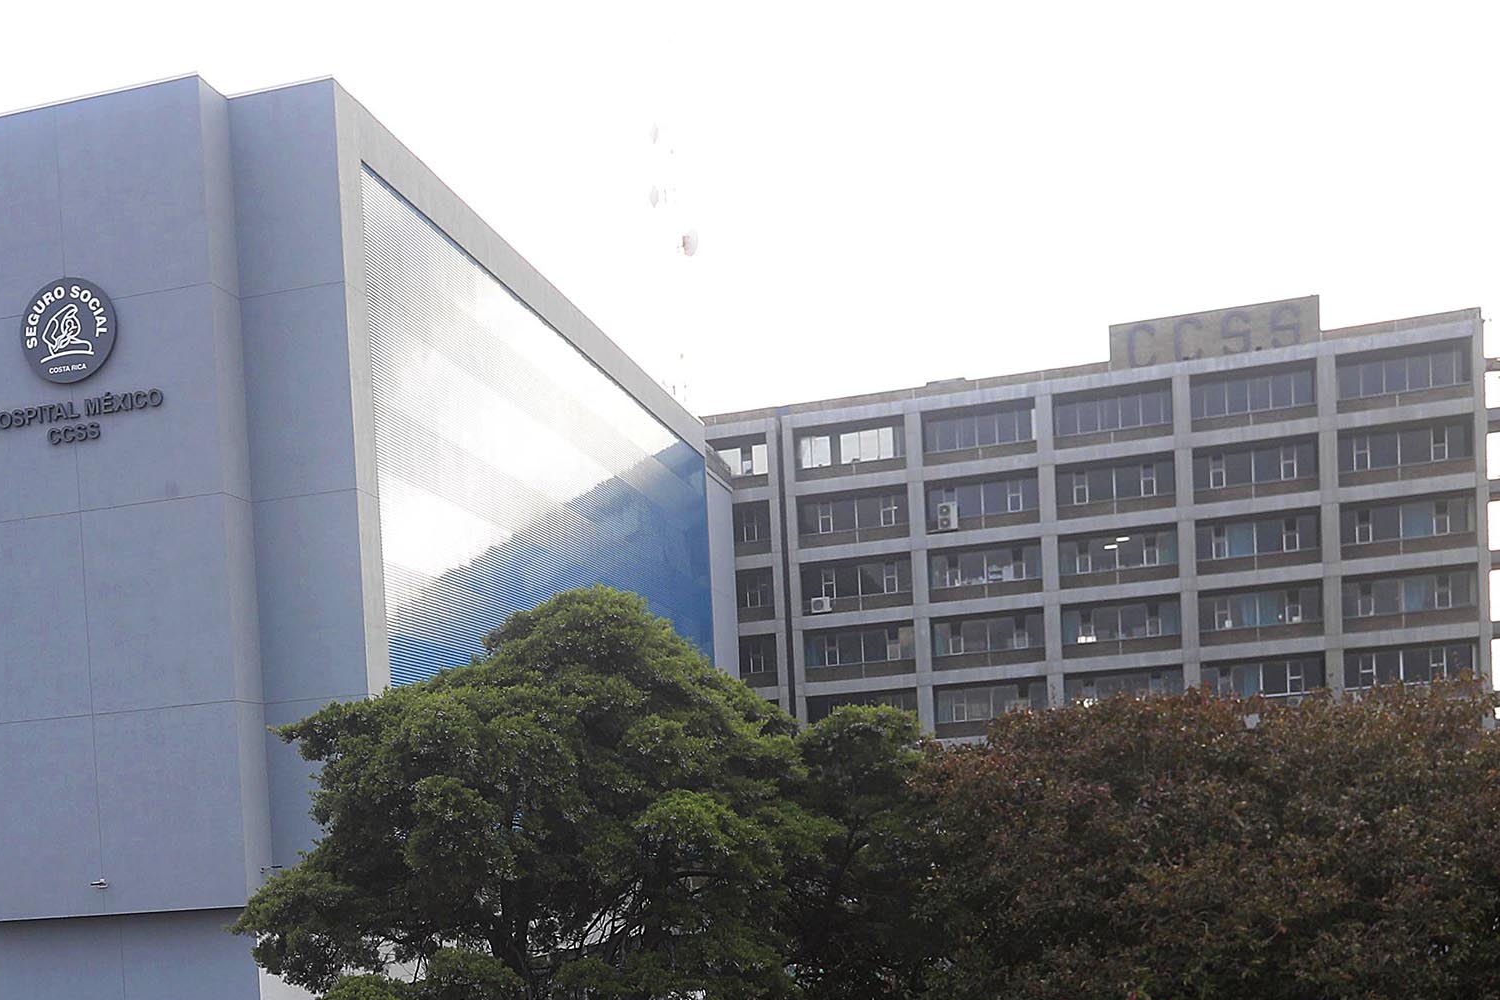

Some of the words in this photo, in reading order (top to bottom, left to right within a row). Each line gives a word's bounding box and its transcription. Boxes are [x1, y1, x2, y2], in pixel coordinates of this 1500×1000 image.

[26, 286, 65, 348] SEGURO
[70, 285, 107, 337] SOCIAL
[1127, 303, 1301, 368] CCSS
[49, 366, 70, 374] COSTA
[71, 363, 87, 371] RICA
[84, 388, 164, 416] MÉXICO
[47, 422, 101, 445] CCSS
